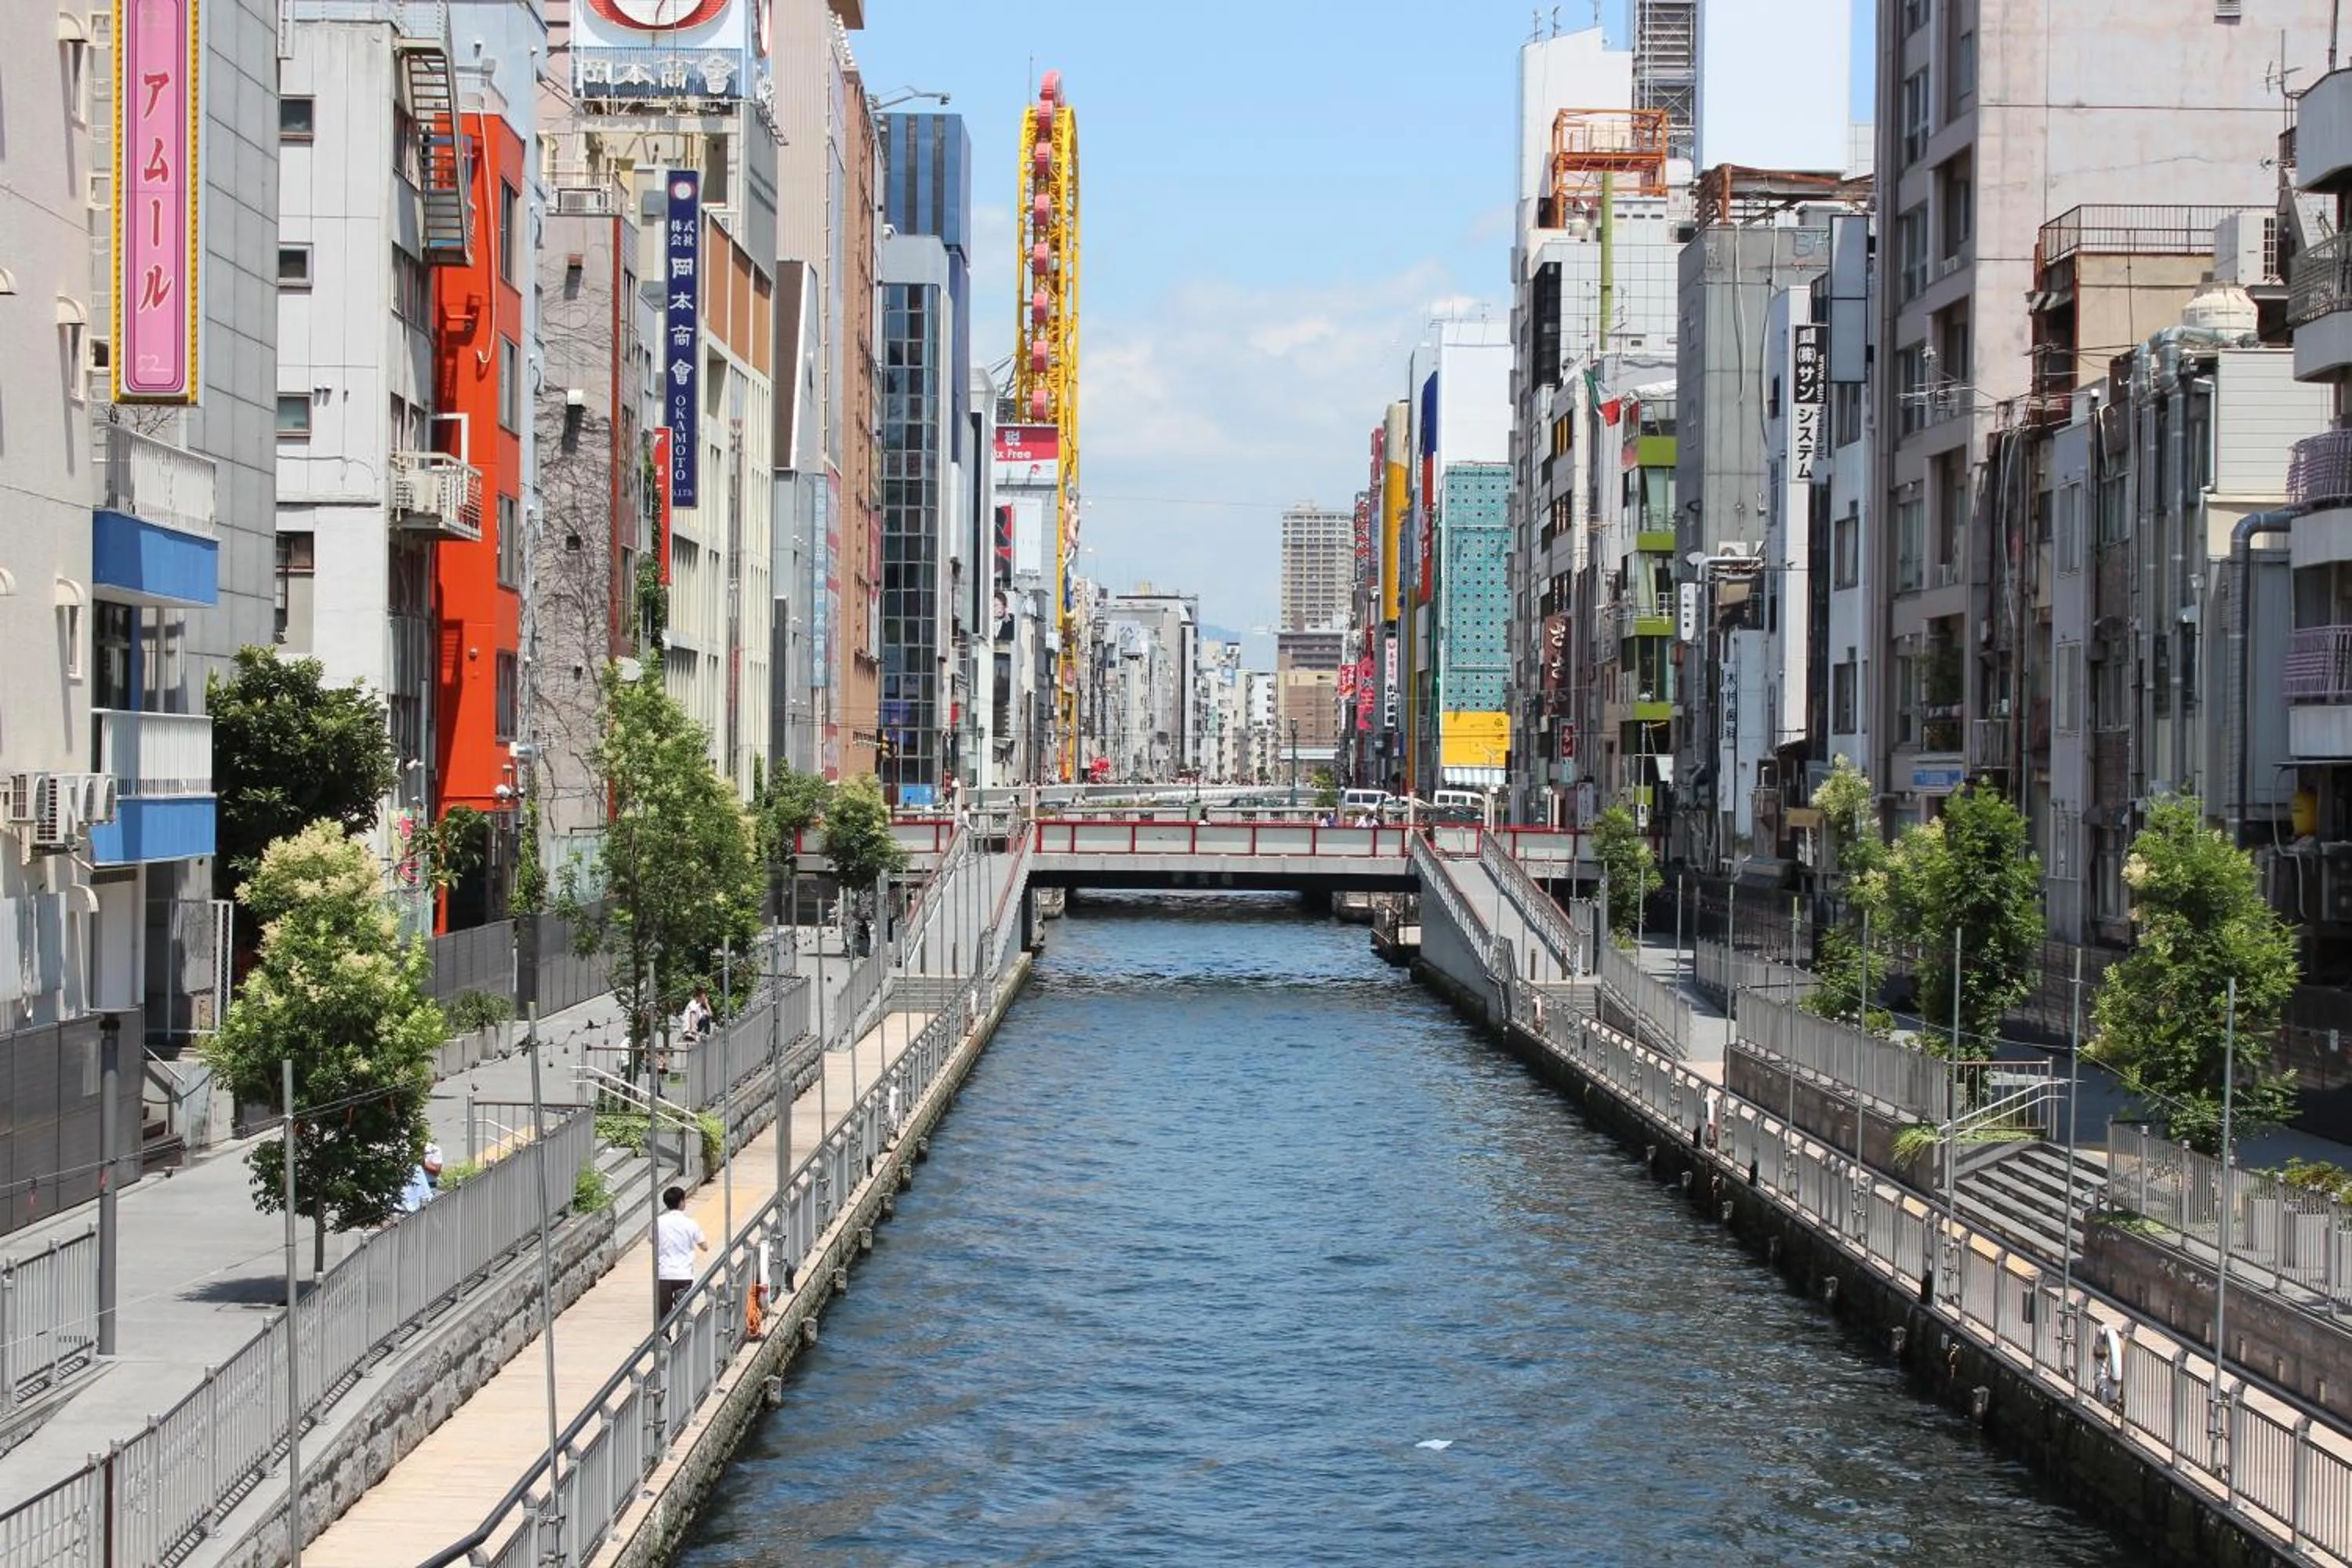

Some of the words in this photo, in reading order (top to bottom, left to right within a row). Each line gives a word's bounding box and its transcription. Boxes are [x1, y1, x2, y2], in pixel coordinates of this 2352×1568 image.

[139, 71, 172, 312] アムール
[674, 394, 688, 481] OKAMOTO
[1007, 449, 1032, 459] Free
